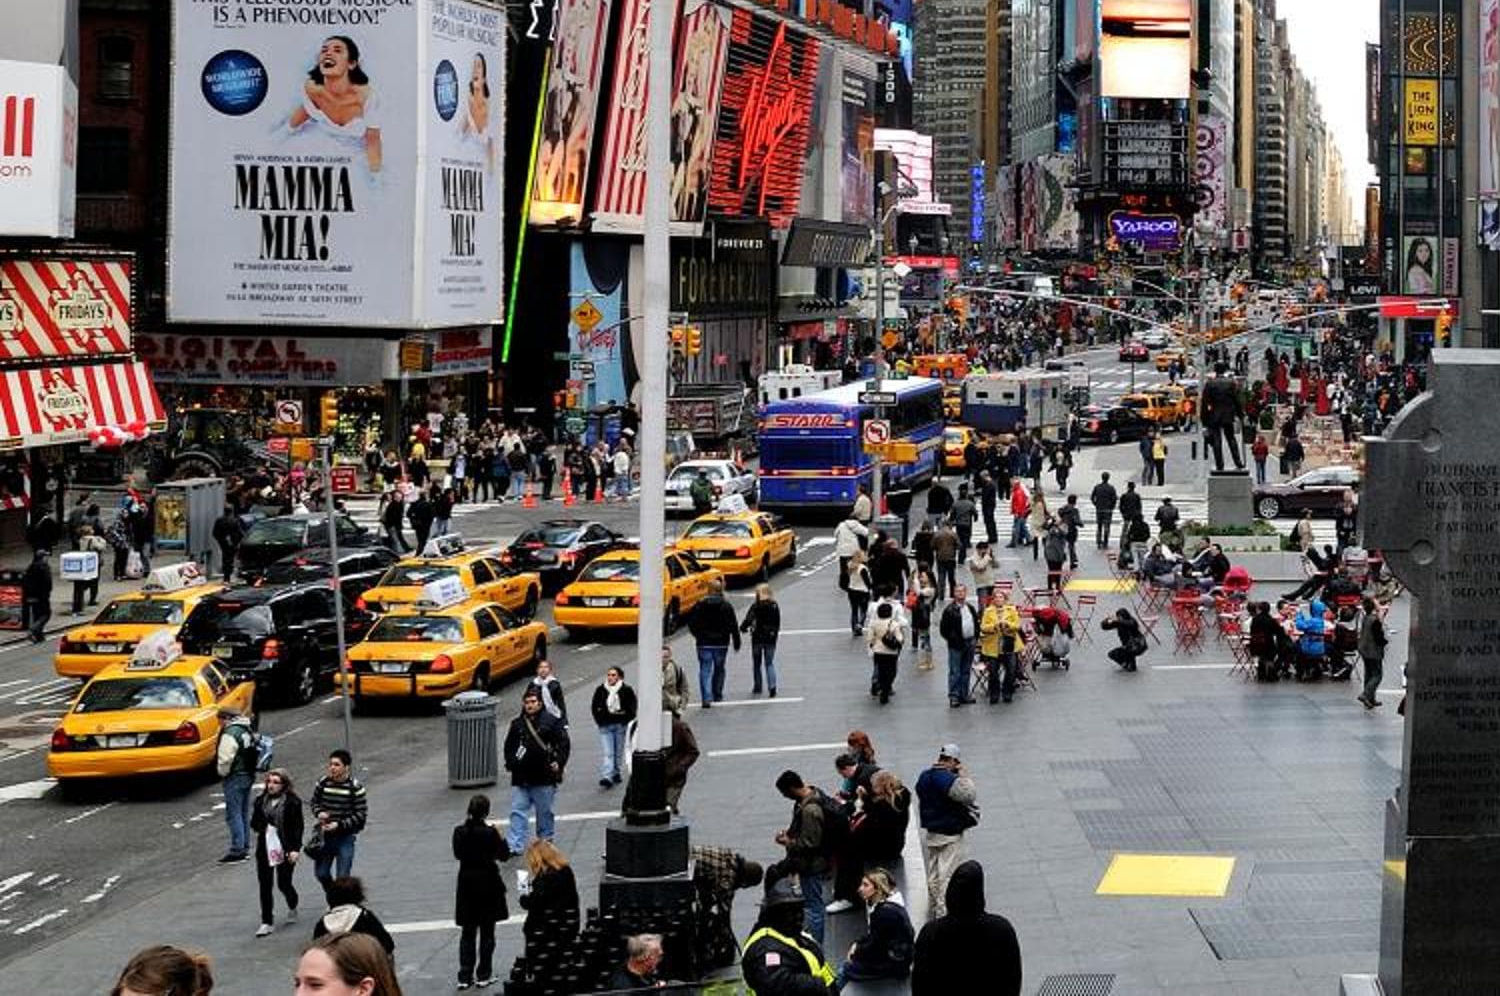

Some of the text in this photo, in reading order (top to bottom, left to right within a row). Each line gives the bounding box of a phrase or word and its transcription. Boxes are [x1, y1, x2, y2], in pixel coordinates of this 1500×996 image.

[213, 6, 387, 25] IS A PHENOMENON!"
[1412, 91, 1431, 102] THE
[1408, 102, 1434, 119] LION
[1407, 120, 1435, 136] KING
[234, 164, 355, 212] MAMMA
[441, 166, 484, 211] MAMMA
[259, 214, 330, 261] MIA!
[450, 213, 475, 256] MIA!
[717, 238, 754, 249] FOREVER
[136, 338, 306, 361] DIGITAL
[227, 359, 337, 373] COMPUTERS
[774, 415, 835, 428] STARR
[1417, 480, 1488, 496] FRANCIS
